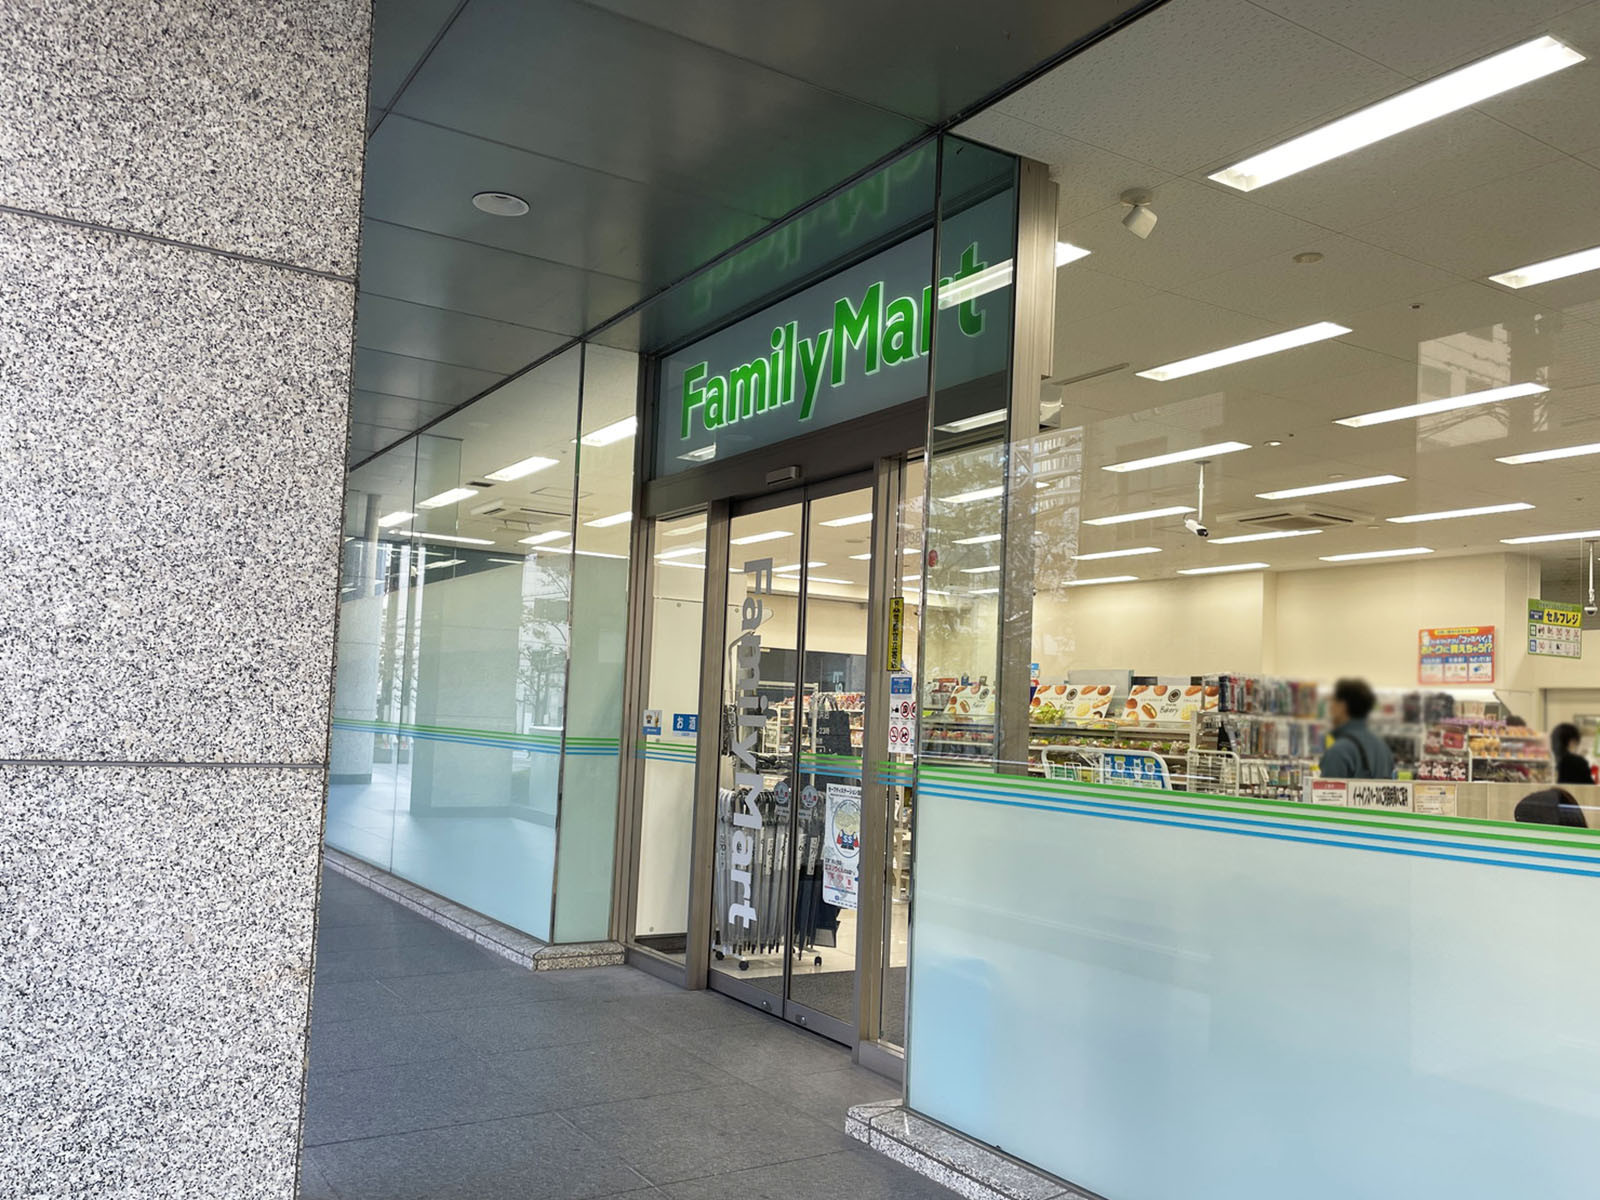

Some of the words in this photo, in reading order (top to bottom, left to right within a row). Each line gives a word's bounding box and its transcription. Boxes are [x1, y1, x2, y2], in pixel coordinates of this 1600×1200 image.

[680, 241, 988, 440] FamilyMart
[1546, 610, 1579, 625] セルフレジ
[1159, 705, 1179, 717] Bakery
[728, 557, 773, 929] FamilyMart
[842, 834, 853, 844] SS
